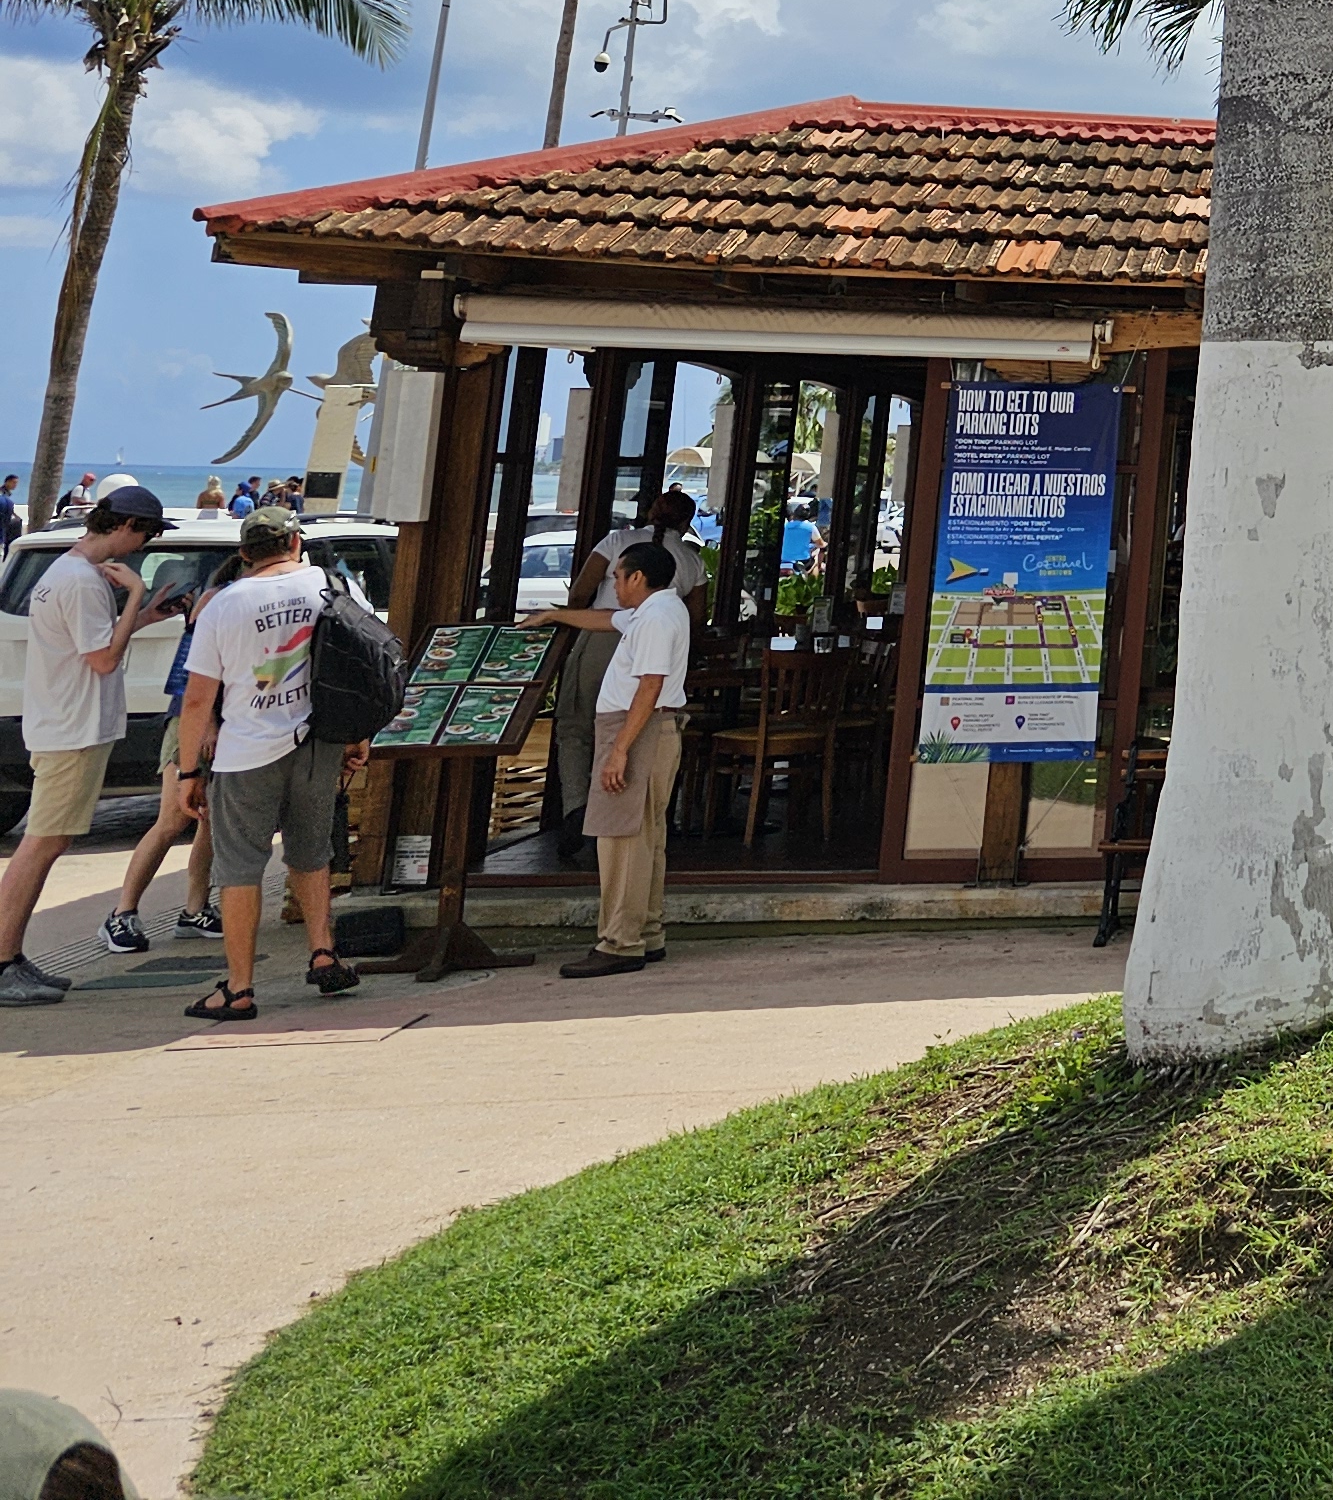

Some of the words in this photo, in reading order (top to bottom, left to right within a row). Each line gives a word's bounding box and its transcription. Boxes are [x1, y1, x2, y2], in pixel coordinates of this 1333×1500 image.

[958, 390, 986, 412] HOW
[989, 390, 1004, 412] TO
[1006, 390, 1030, 412] GET
[1032, 391, 1048, 412] TO
[1050, 392, 1075, 414] OUR
[956, 412, 1007, 435] PARKING
[1008, 414, 1040, 435] LOTS
[951, 472, 985, 494] COMO
[987, 472, 1030, 495] LLEGAR
[1032, 473, 1040, 495] A
[1043, 474, 1106, 496] NUESTROS
[949, 494, 1066, 518] ESTACIONAMIENTOS
[1023, 552, 1093, 572] Cozumel
[259, 601, 275, 613] LIFE
[278, 600, 285, 608] IS
[287, 596, 306, 606] JUST
[255, 608, 312, 634] BETTER
[250, 695, 266, 710] IN
[196, 916, 214, 928] N
